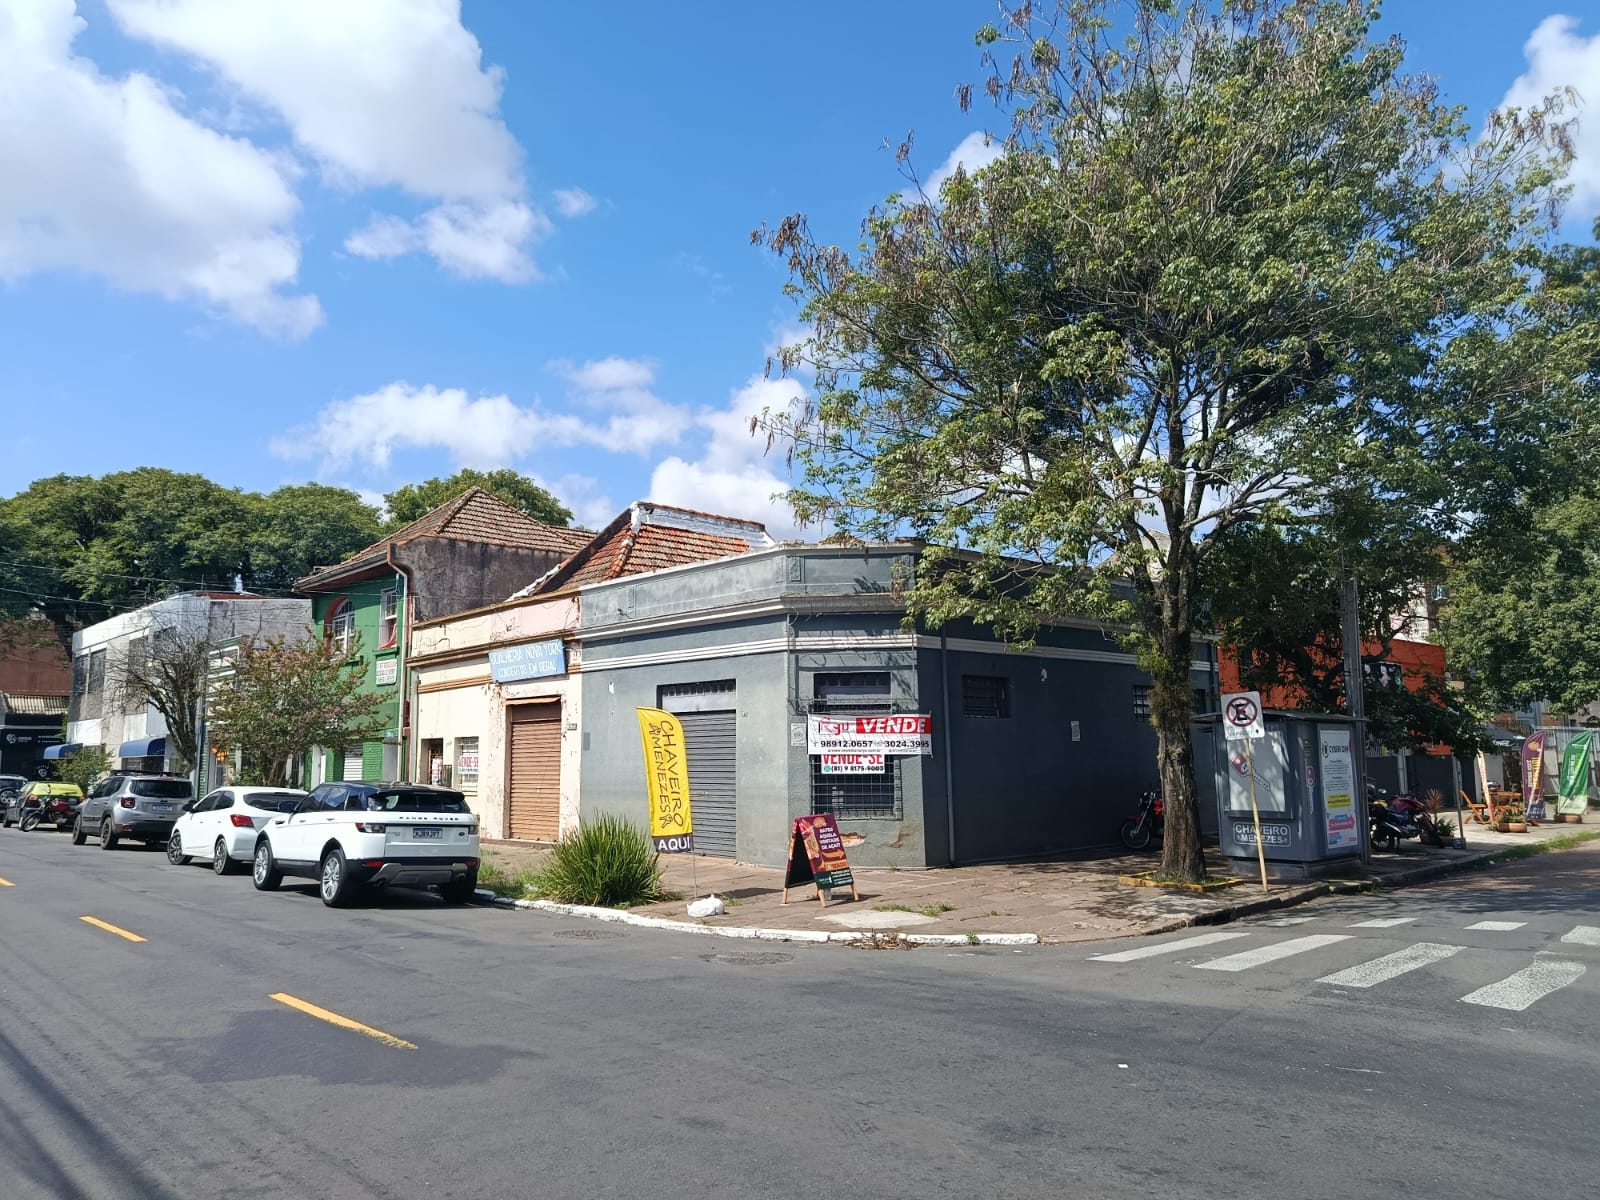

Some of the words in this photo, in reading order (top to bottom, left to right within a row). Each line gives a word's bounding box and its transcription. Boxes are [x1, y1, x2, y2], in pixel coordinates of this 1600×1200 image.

[525, 644, 543, 659] NOVA
[544, 641, 562, 656] YORK
[861, 718, 926, 733] VENDE
[823, 754, 883, 765] VENDE-SE
[652, 736, 671, 813] MENEZES
[660, 720, 684, 827] CHAVEIRO
[1235, 825, 1288, 836] CHAEIRO
[658, 836, 690, 851] AQUI
